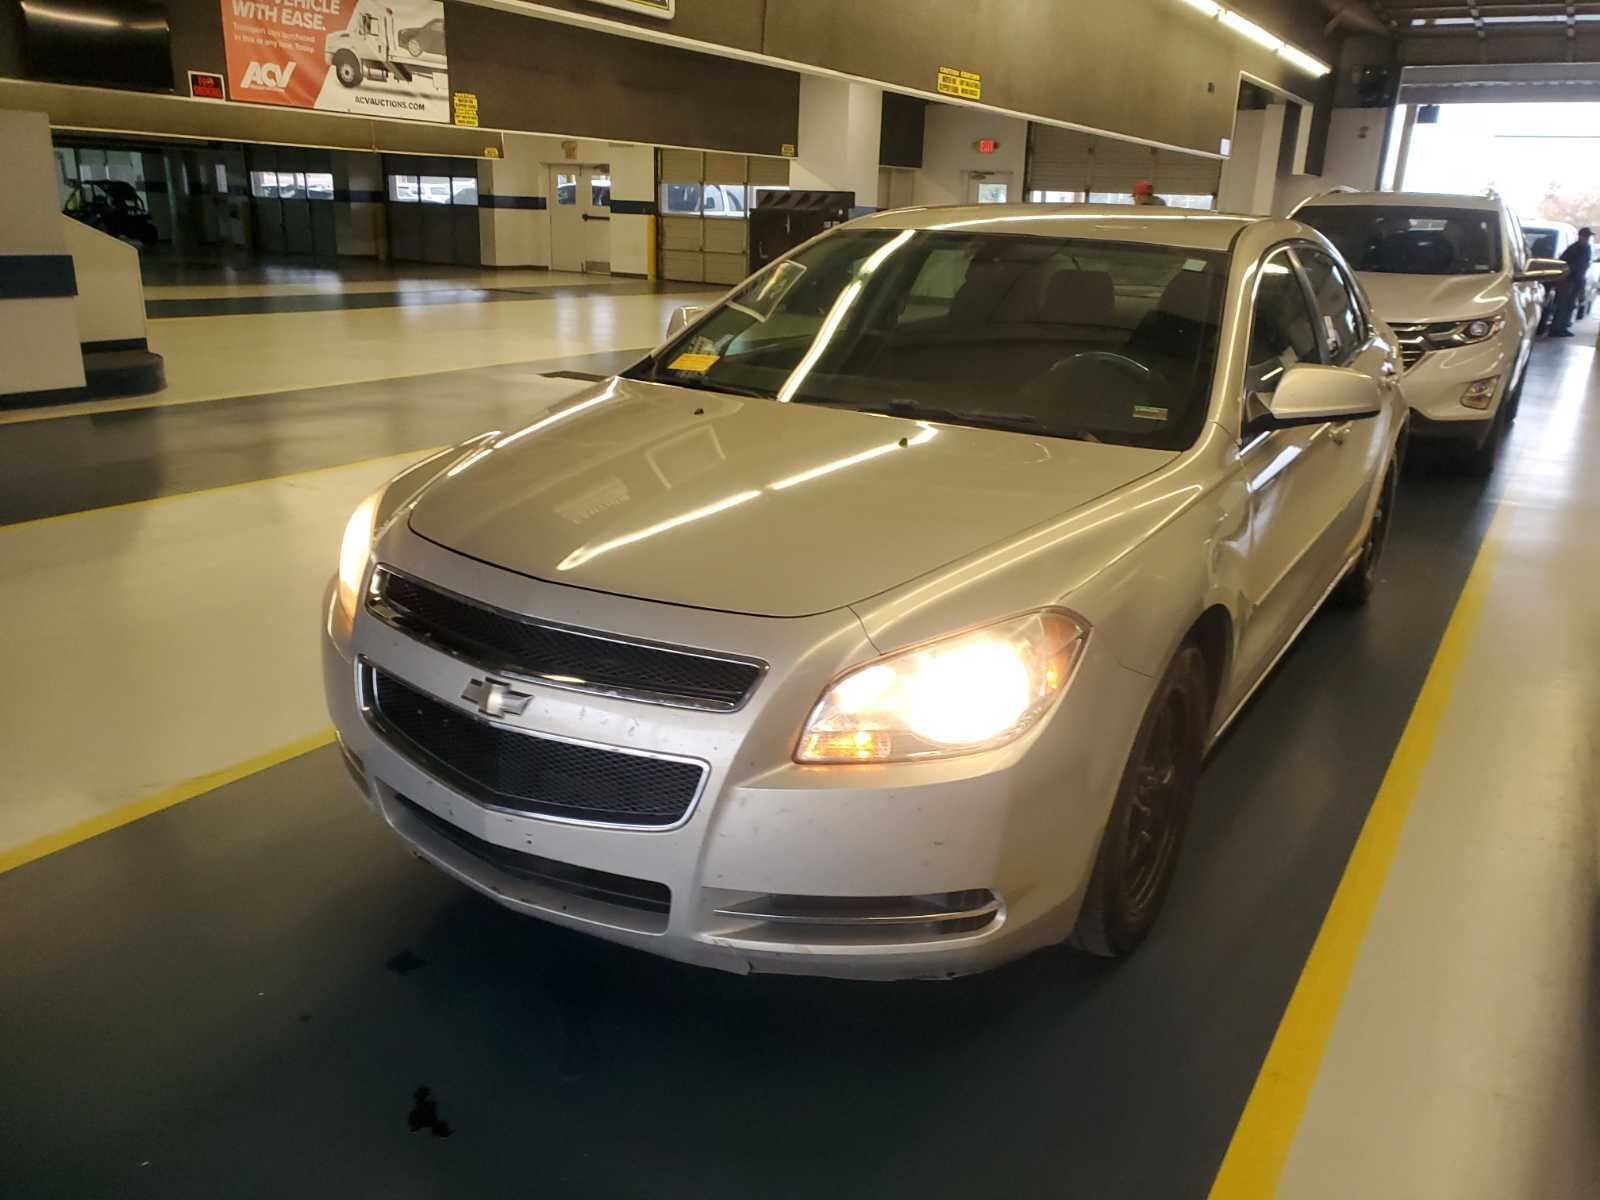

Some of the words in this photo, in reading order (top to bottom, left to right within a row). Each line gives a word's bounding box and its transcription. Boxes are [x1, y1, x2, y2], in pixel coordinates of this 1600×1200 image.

[232, 1, 277, 23] WITH
[281, 8, 326, 31] EASE.
[275, 0, 340, 15] HICLE
[240, 61, 297, 89] ACV
[355, 95, 425, 111] ACVAUCTIONS.COM
